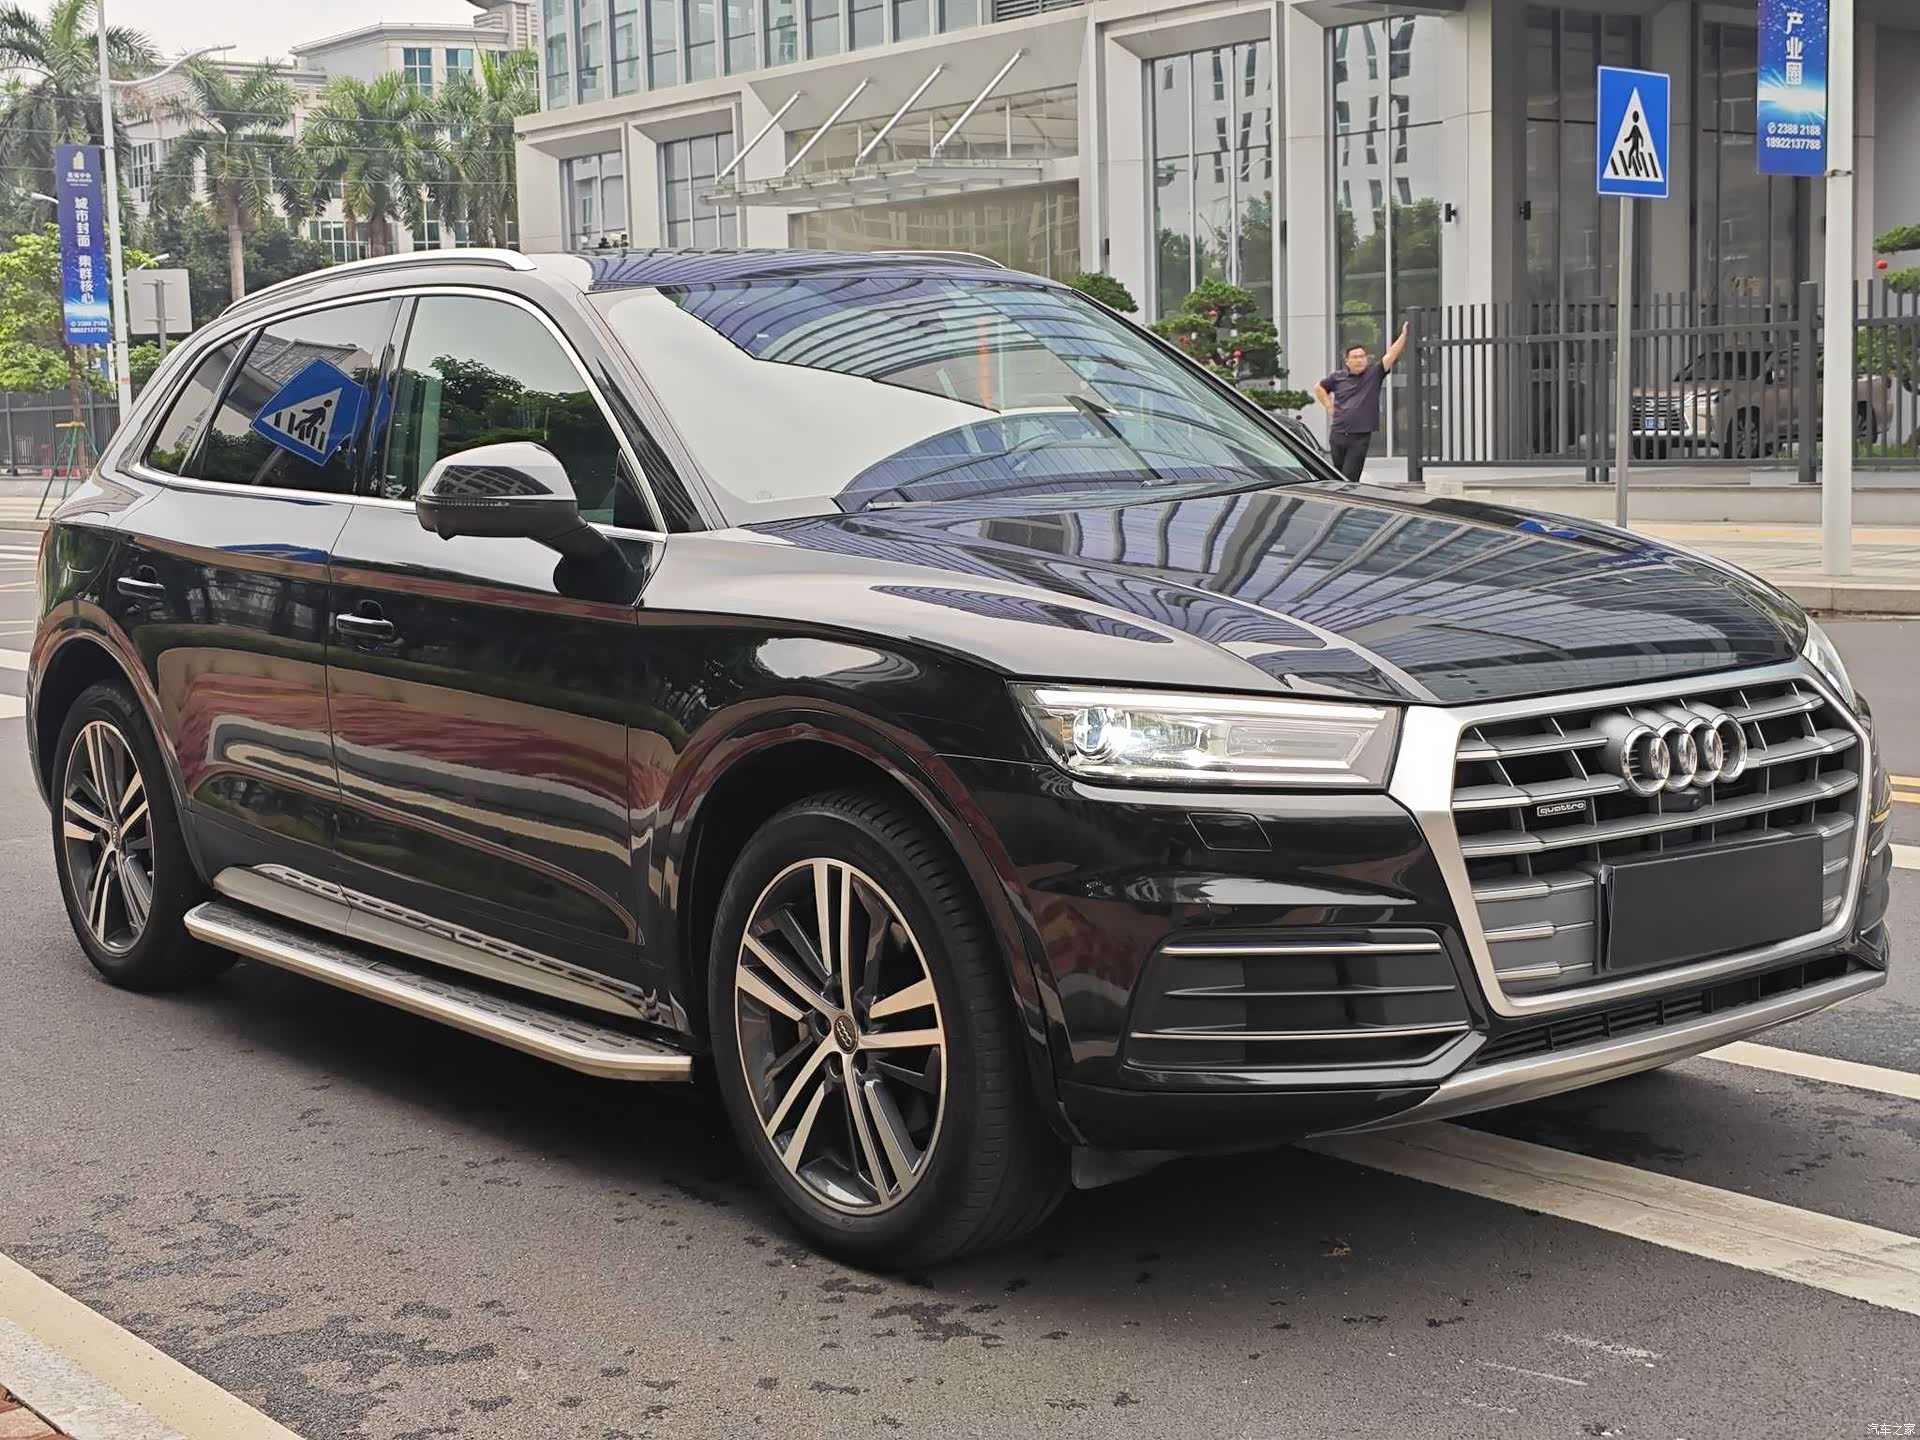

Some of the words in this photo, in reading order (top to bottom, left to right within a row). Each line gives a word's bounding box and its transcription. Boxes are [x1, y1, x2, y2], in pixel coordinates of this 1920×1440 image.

[1777, 123, 1798, 135] 2388
[1800, 124, 1821, 136] 2188
[1540, 802, 1584, 814] quattro
